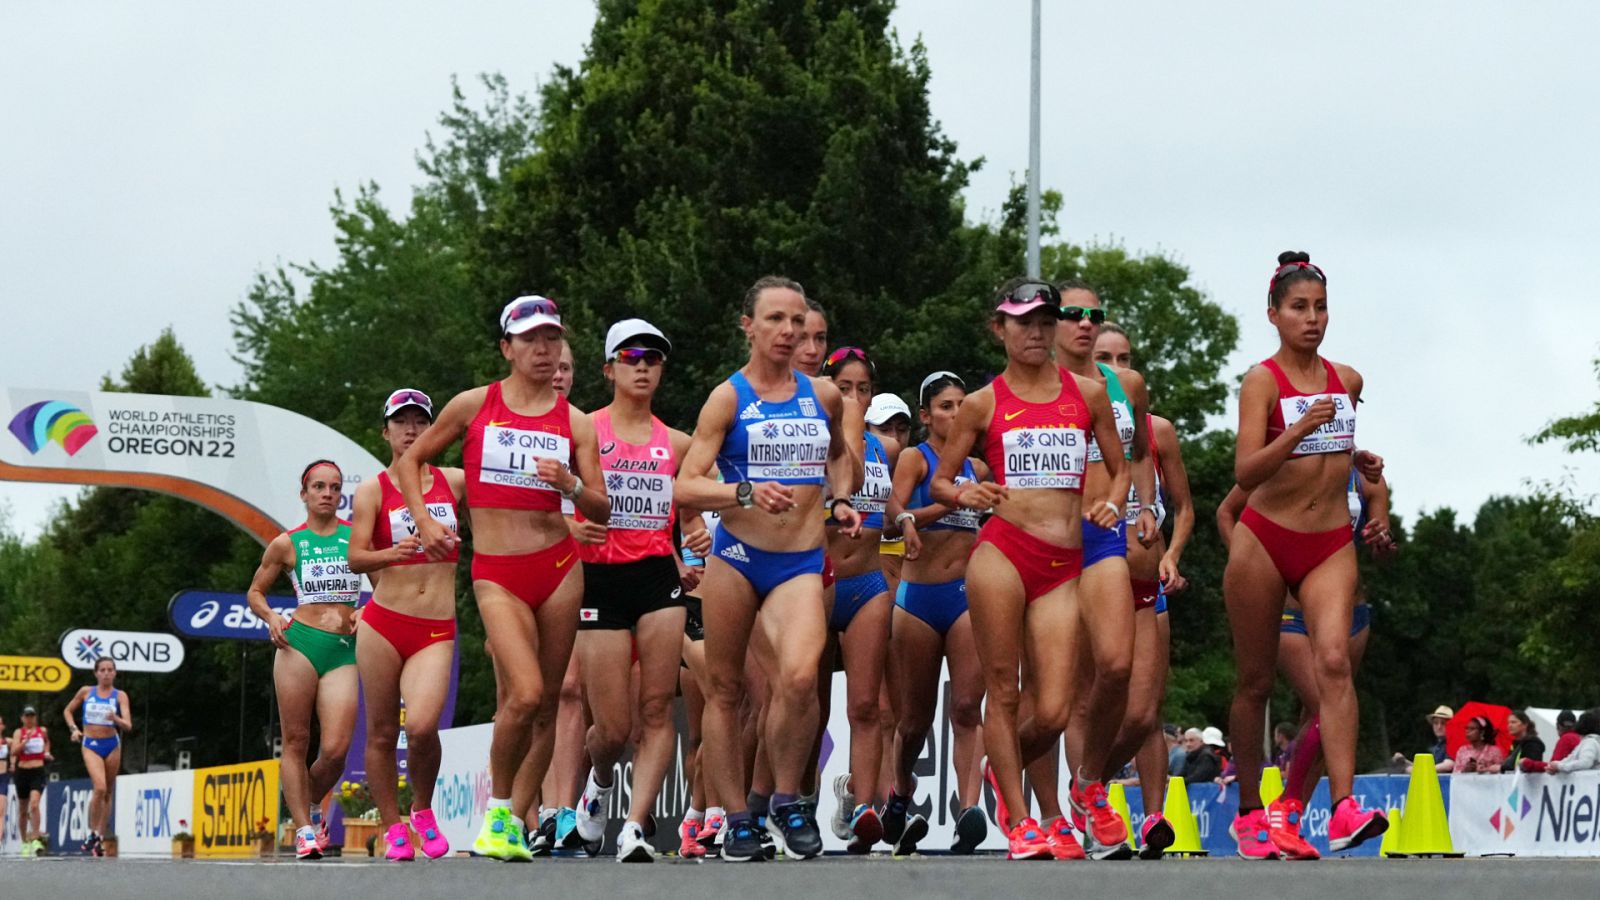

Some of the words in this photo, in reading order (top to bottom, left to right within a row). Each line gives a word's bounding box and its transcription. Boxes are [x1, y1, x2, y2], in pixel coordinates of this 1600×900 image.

[109, 409, 158, 422] WORLD
[162, 412, 235, 425] ATHLETICS
[108, 422, 235, 439] CHAMPIONSHIPS
[782, 423, 819, 437] QNB
[108, 437, 203, 456] OREGON
[207, 440, 235, 458] 22
[519, 434, 558, 451] QNB
[1038, 433, 1077, 448] QNB
[509, 452, 526, 471] LI
[751, 444, 813, 462] NTRISMPIOTI
[611, 458, 658, 472] JAPAN
[1008, 453, 1070, 473] QIEYANG
[763, 468, 815, 478] OREGON22
[627, 476, 667, 492] QNB
[426, 506, 447, 518] NB
[657, 501, 670, 515] 142
[721, 549, 750, 564] adidas
[305, 579, 348, 593] OLIVEIRA
[110, 641, 170, 668] QNB
[0, 664, 61, 683] EIKO
[144, 787, 173, 838] TDK
[202, 768, 266, 848] SEIKO
[1535, 784, 1600, 843] Niel
